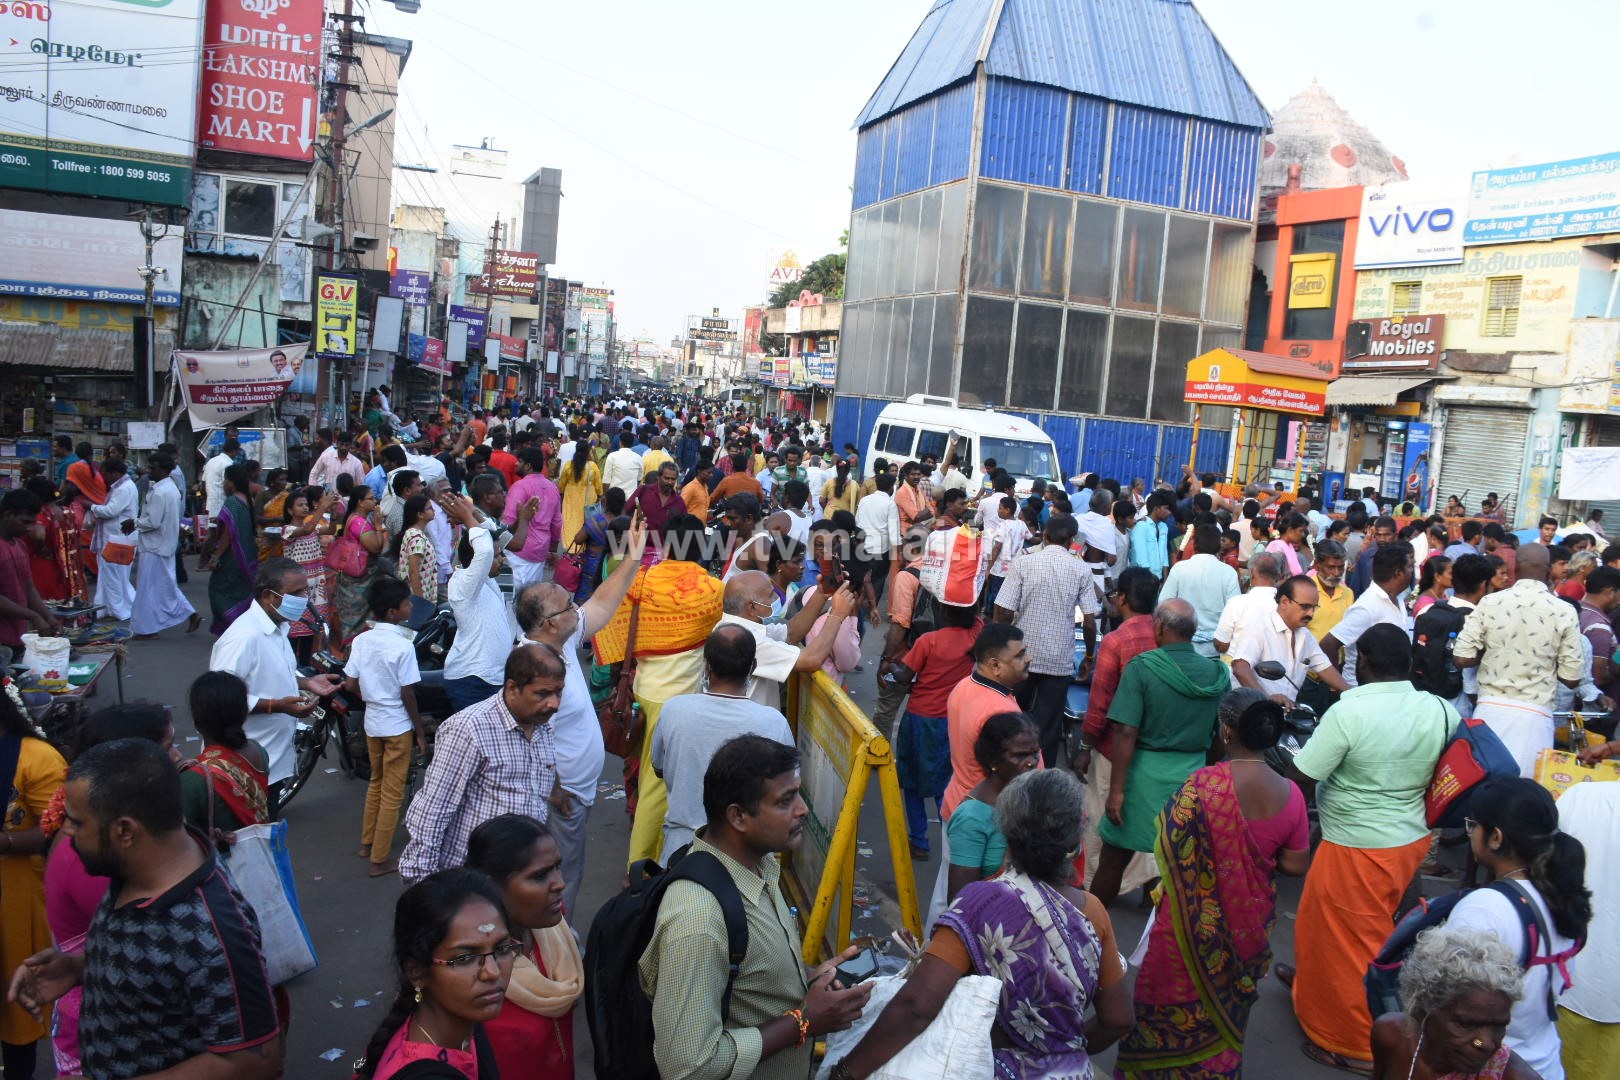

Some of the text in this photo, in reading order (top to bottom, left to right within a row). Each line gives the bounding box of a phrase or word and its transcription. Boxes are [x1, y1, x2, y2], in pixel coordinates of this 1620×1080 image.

[221, 23, 315, 54] மார்ட்
[206, 50, 316, 85] LAKSHMI
[52, 90, 168, 118] திருவண்ணாமலை
[210, 82, 284, 115] SHOE
[208, 114, 296, 145] MART
[51, 159, 91, 173] Tollfree
[100, 165, 124, 177] 1800
[126, 168, 144, 179] 599
[146, 171, 171, 183] 5055
[1368, 205, 1454, 237] vivo
[320, 283, 354, 301] G.V
[1380, 317, 1432, 340] Royal
[1370, 339, 1435, 356] Mobiles
